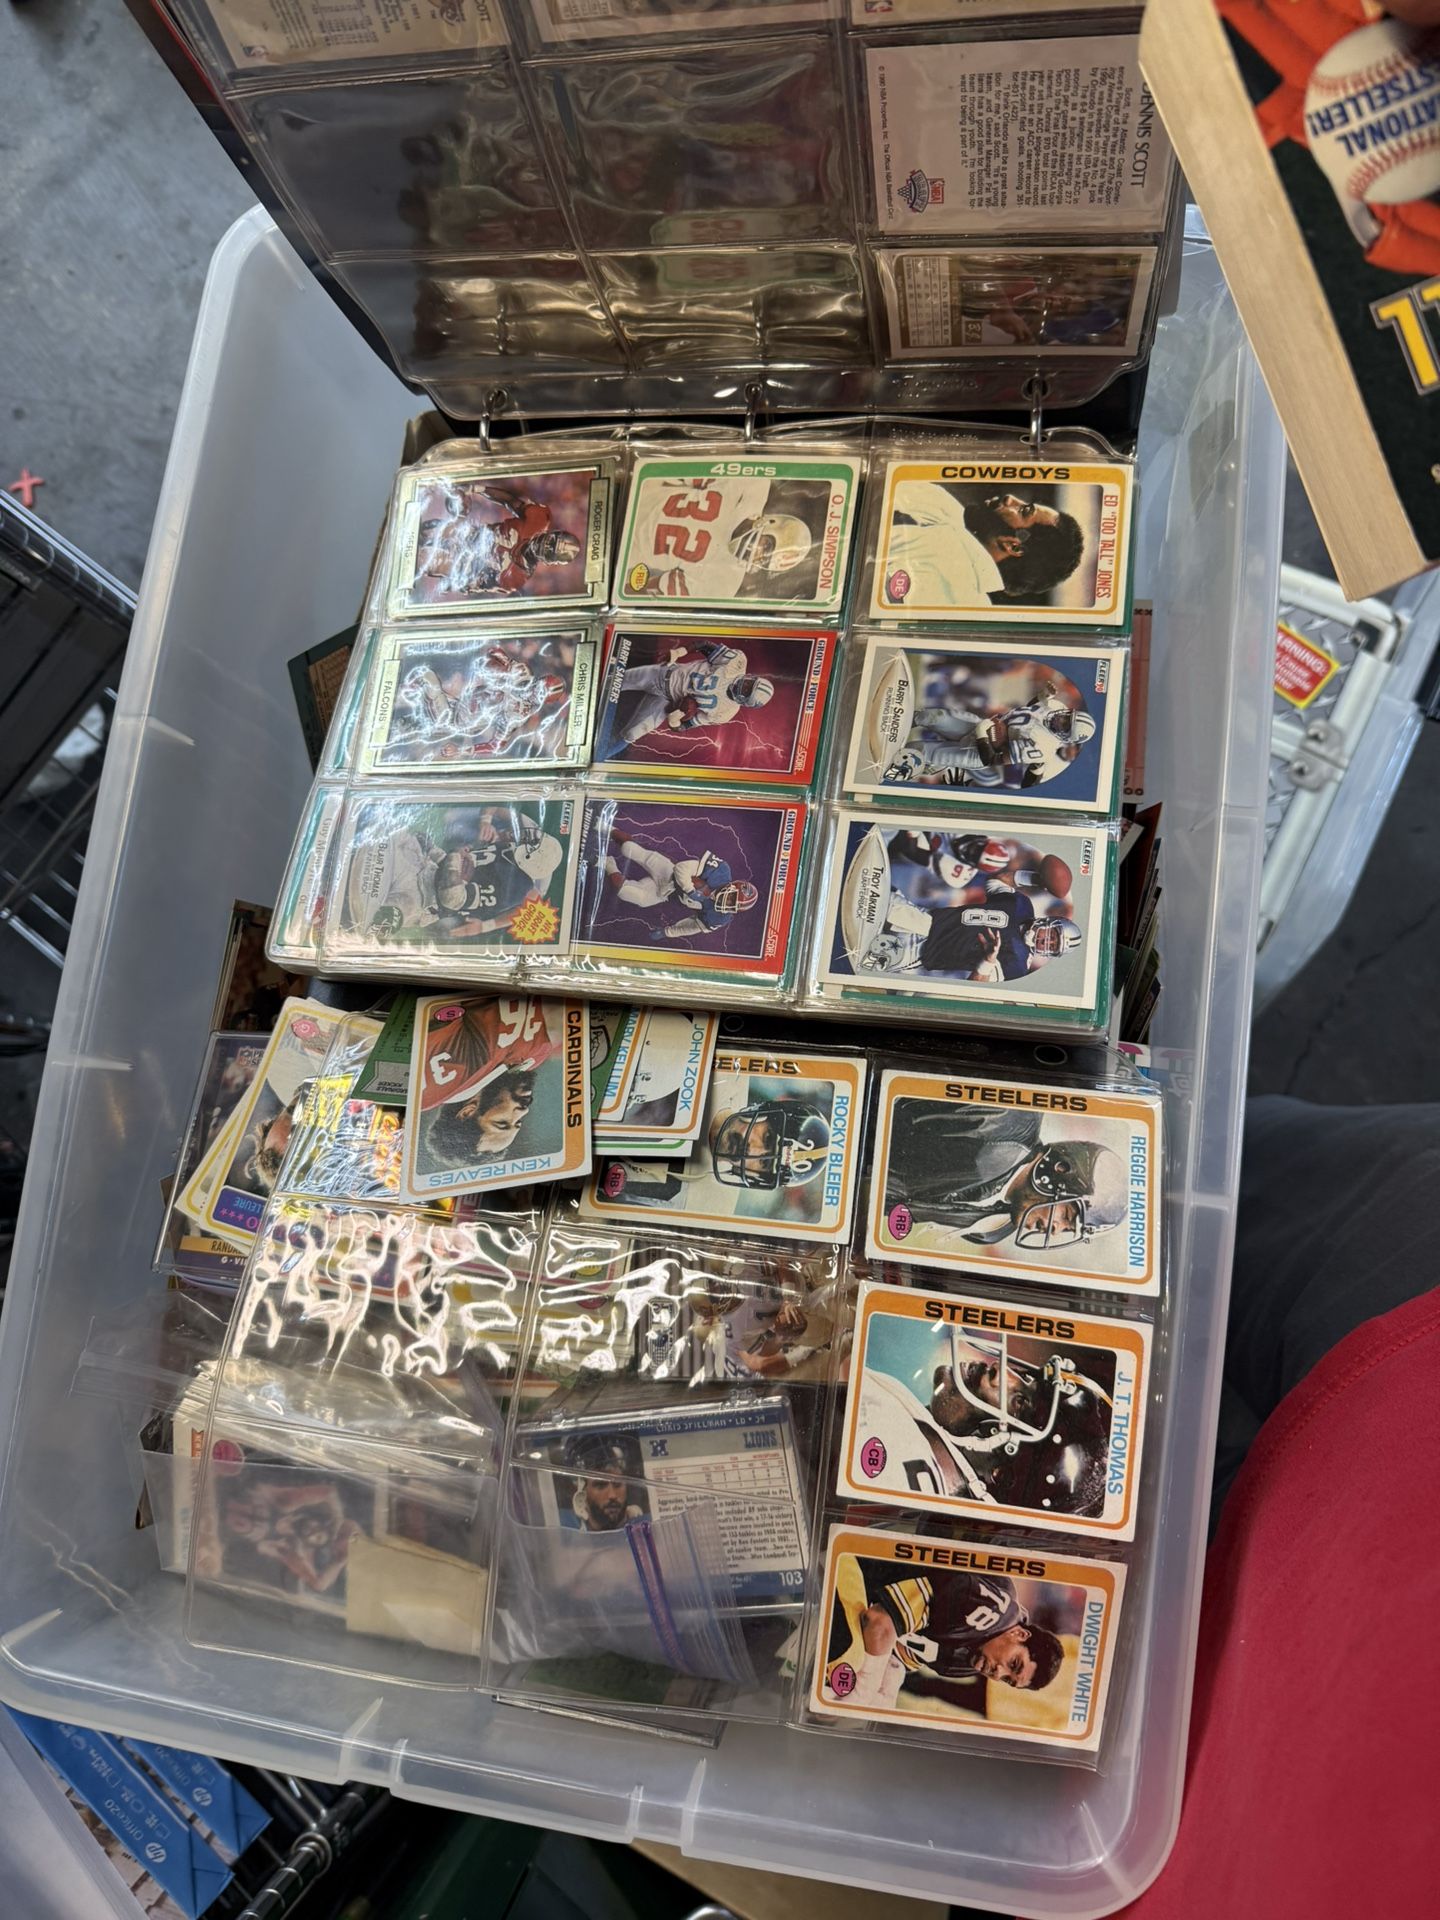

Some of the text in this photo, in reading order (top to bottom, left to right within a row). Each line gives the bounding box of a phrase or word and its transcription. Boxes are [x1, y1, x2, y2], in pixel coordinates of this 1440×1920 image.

[1306, 65, 1436, 139] STSELLER!
[1336, 94, 1440, 158] ATIONAL
[1130, 143, 1149, 188] SCOTT
[710, 463, 776, 477] 49ers
[941, 466, 1071, 480] COWBOYS
[1103, 495, 1119, 507] ED
[591, 501, 603, 561] ROGER CRAIG
[819, 495, 844, 589] O. J. SIMPSON
[1096, 569, 1112, 599] JONES
[609, 639, 632, 704] BARRY SANDERS
[806, 640, 826, 712] GROUND FORCE
[1098, 661, 1107, 683] FLEER
[574, 663, 588, 727] CHRIS MILLER
[896, 680, 909, 706] BARRY
[889, 707, 904, 743] SANDERS
[776, 811, 796, 890] GROUND FORCE
[1083, 840, 1092, 864] FLEER
[370, 843, 388, 898] BLAIR THOMAS
[871, 867, 884, 890] TROY
[856, 868, 869, 919] QUARTERBACK
[866, 890, 880, 924] AIKMAN
[516, 904, 536, 932] CHOICE
[528, 911, 546, 936] DRAFT
[765, 934, 778, 958] SCORE
[566, 1010, 581, 1128] CARDINALS
[679, 1024, 704, 1111] JOHN ZOOK
[713, 1057, 803, 1076] ELERS
[945, 1083, 1088, 1112] STEELERS
[825, 1095, 848, 1206] ROCKY BLEIER
[429, 1157, 551, 1187] KEN REAVES
[608, 1172, 617, 1187] RB
[1129, 1135, 1147, 1267] REGGIE HARRISON
[896, 1214, 906, 1232] RB
[925, 1301, 1075, 1339] STEELERS
[1108, 1371, 1133, 1495] J. T. THOMAS
[868, 1448, 878, 1467] CB
[895, 1543, 1045, 1577] STEELERS
[779, 1571, 803, 1586] 103
[1072, 1601, 1104, 1722] DWIGHT WHITE
[838, 1672, 849, 1688] DE
[145, 1842, 166, 1863] hp
